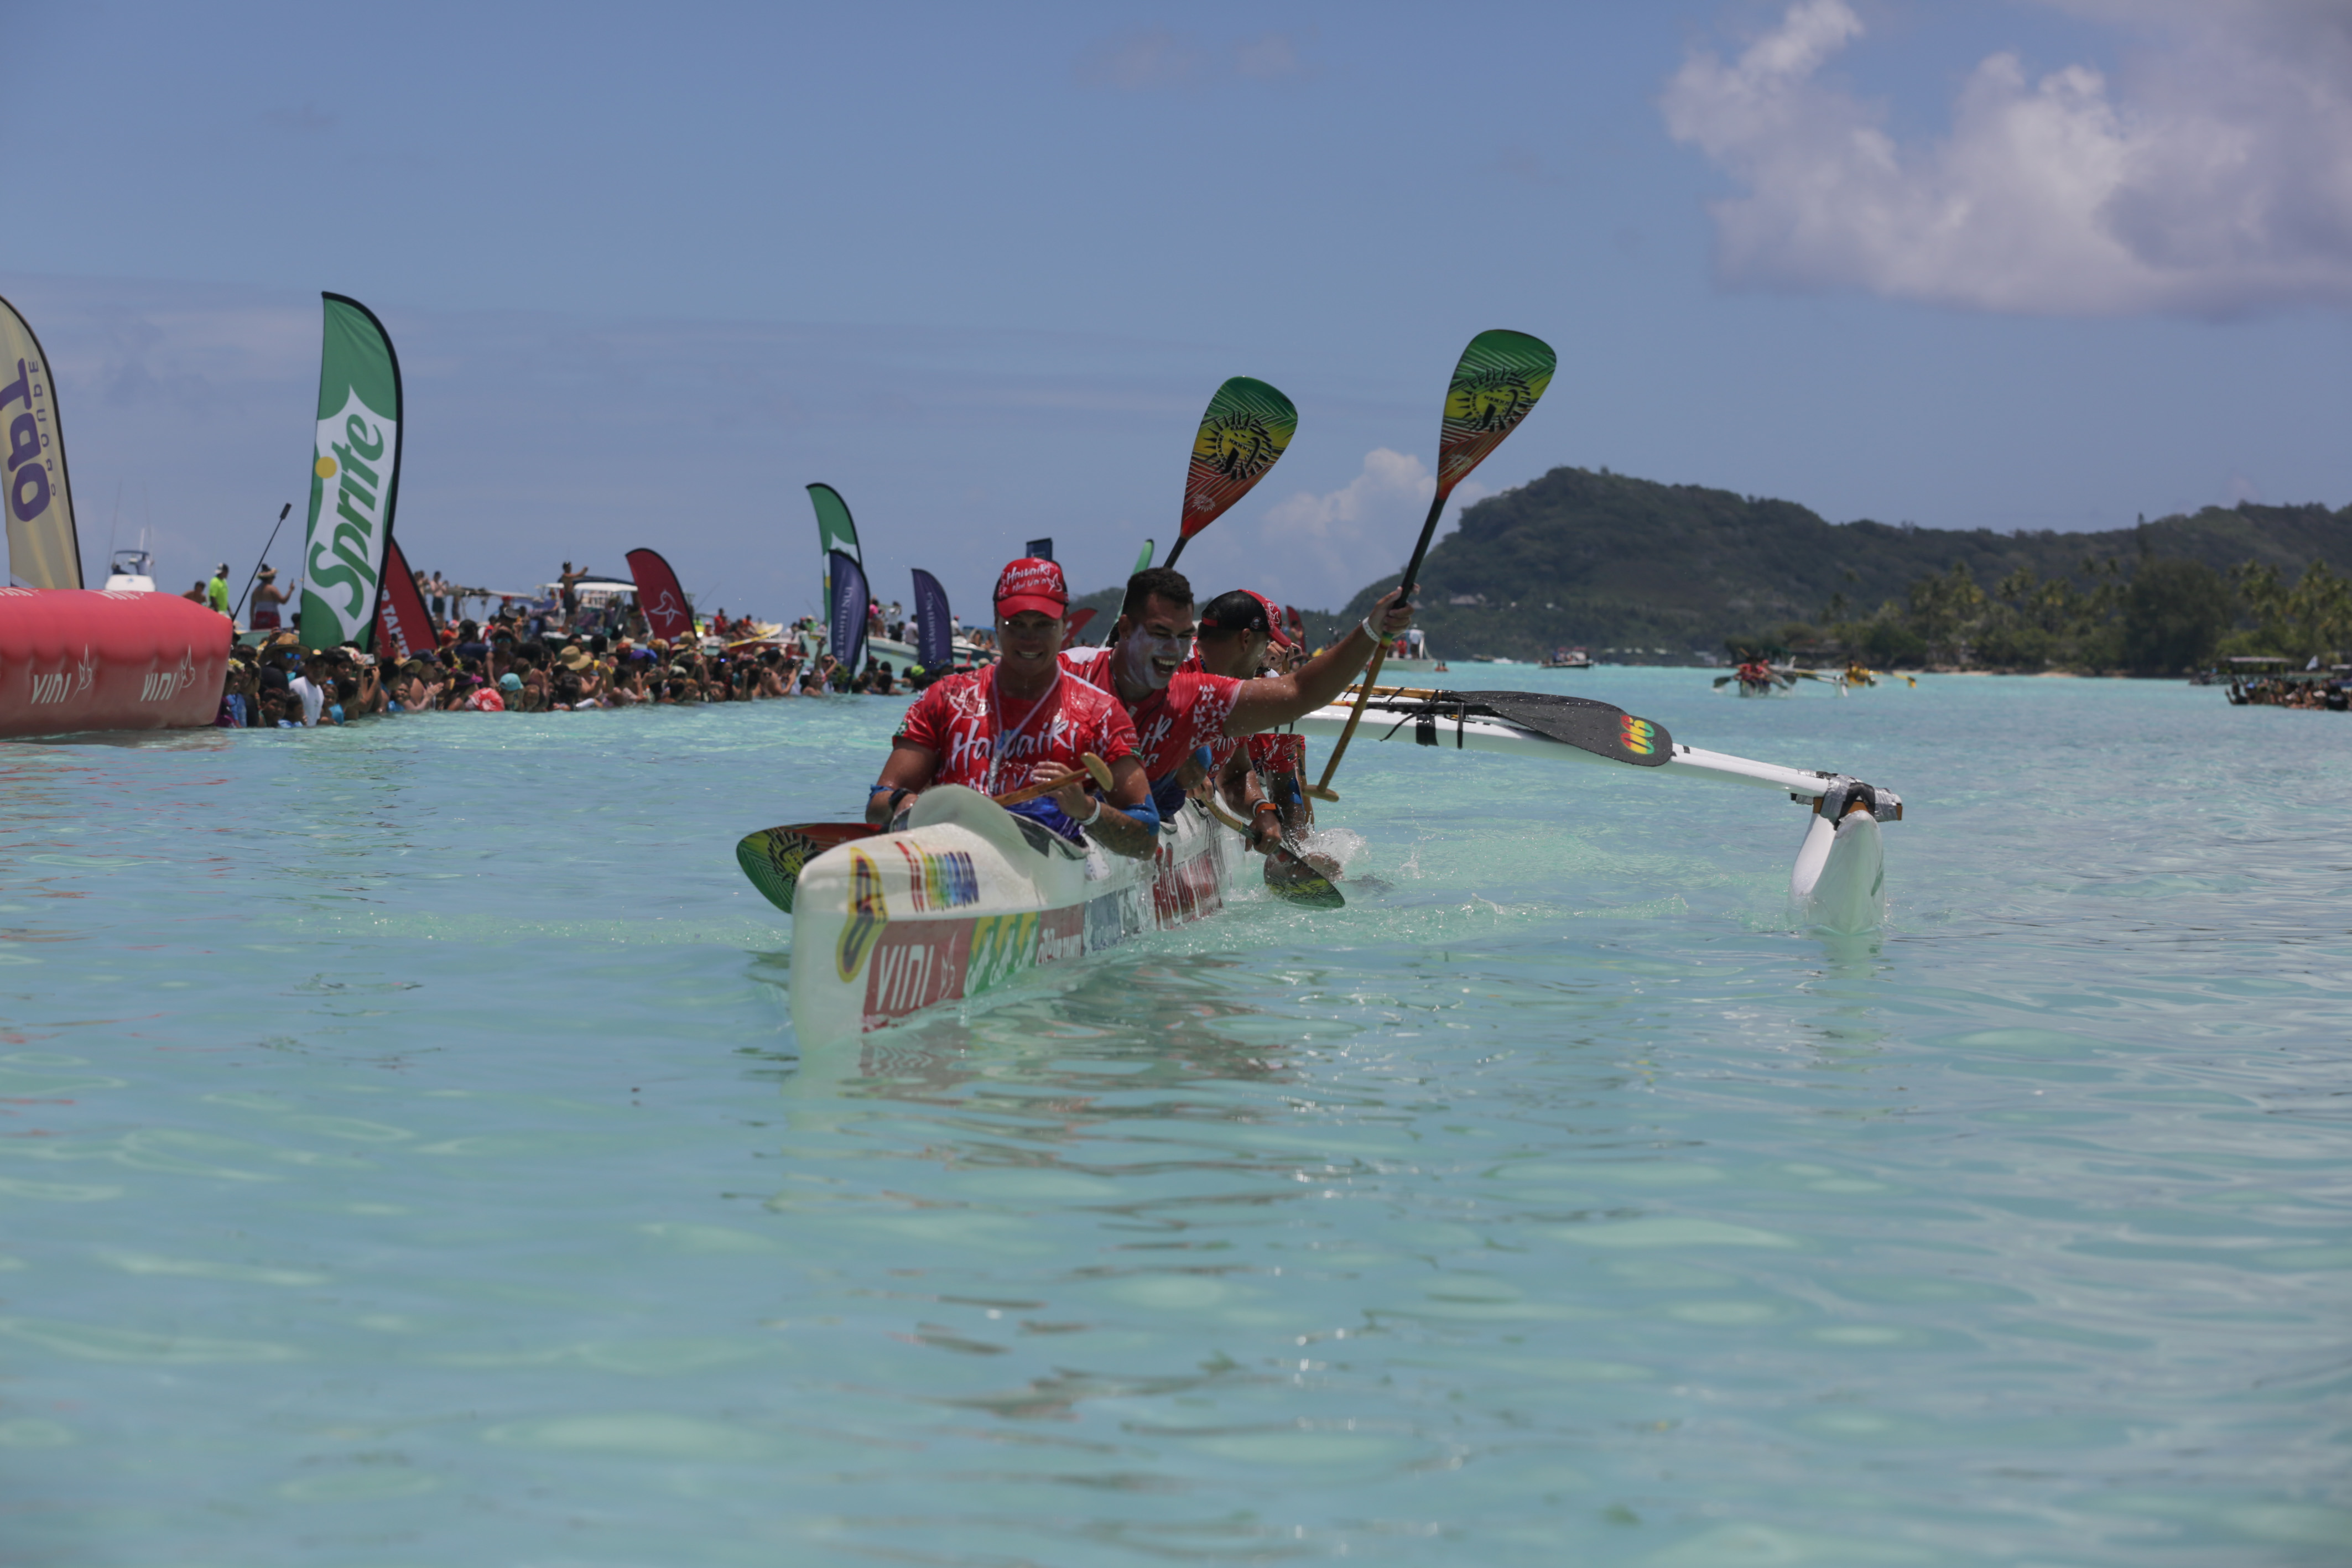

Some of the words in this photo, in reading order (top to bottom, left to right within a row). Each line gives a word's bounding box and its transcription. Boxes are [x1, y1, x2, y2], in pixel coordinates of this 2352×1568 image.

[309, 414, 384, 621] Sprite
[31, 673, 71, 704] VINI
[140, 673, 178, 702] VINI
[876, 945, 935, 1012] VINI
